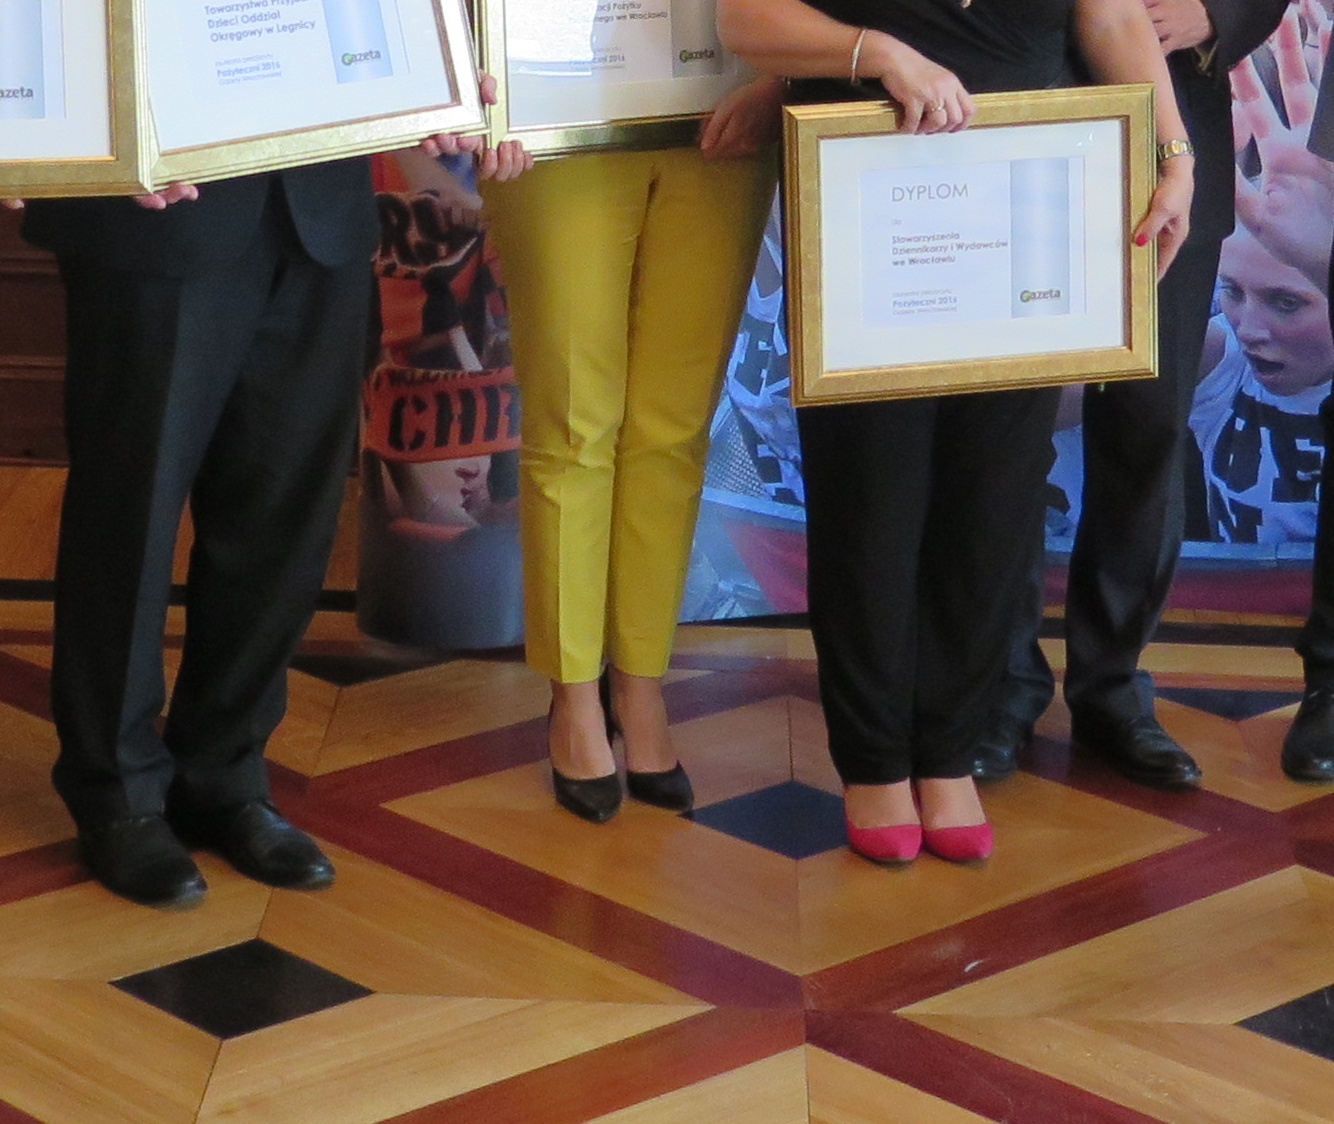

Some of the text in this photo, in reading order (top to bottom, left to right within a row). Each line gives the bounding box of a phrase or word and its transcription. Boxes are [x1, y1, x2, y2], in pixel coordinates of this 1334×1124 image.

[341, 48, 381, 66] Gazeta
[679, 48, 715, 63] Gazeta
[891, 183, 969, 203] DYPLOM
[1020, 287, 1061, 304] Gazeta
